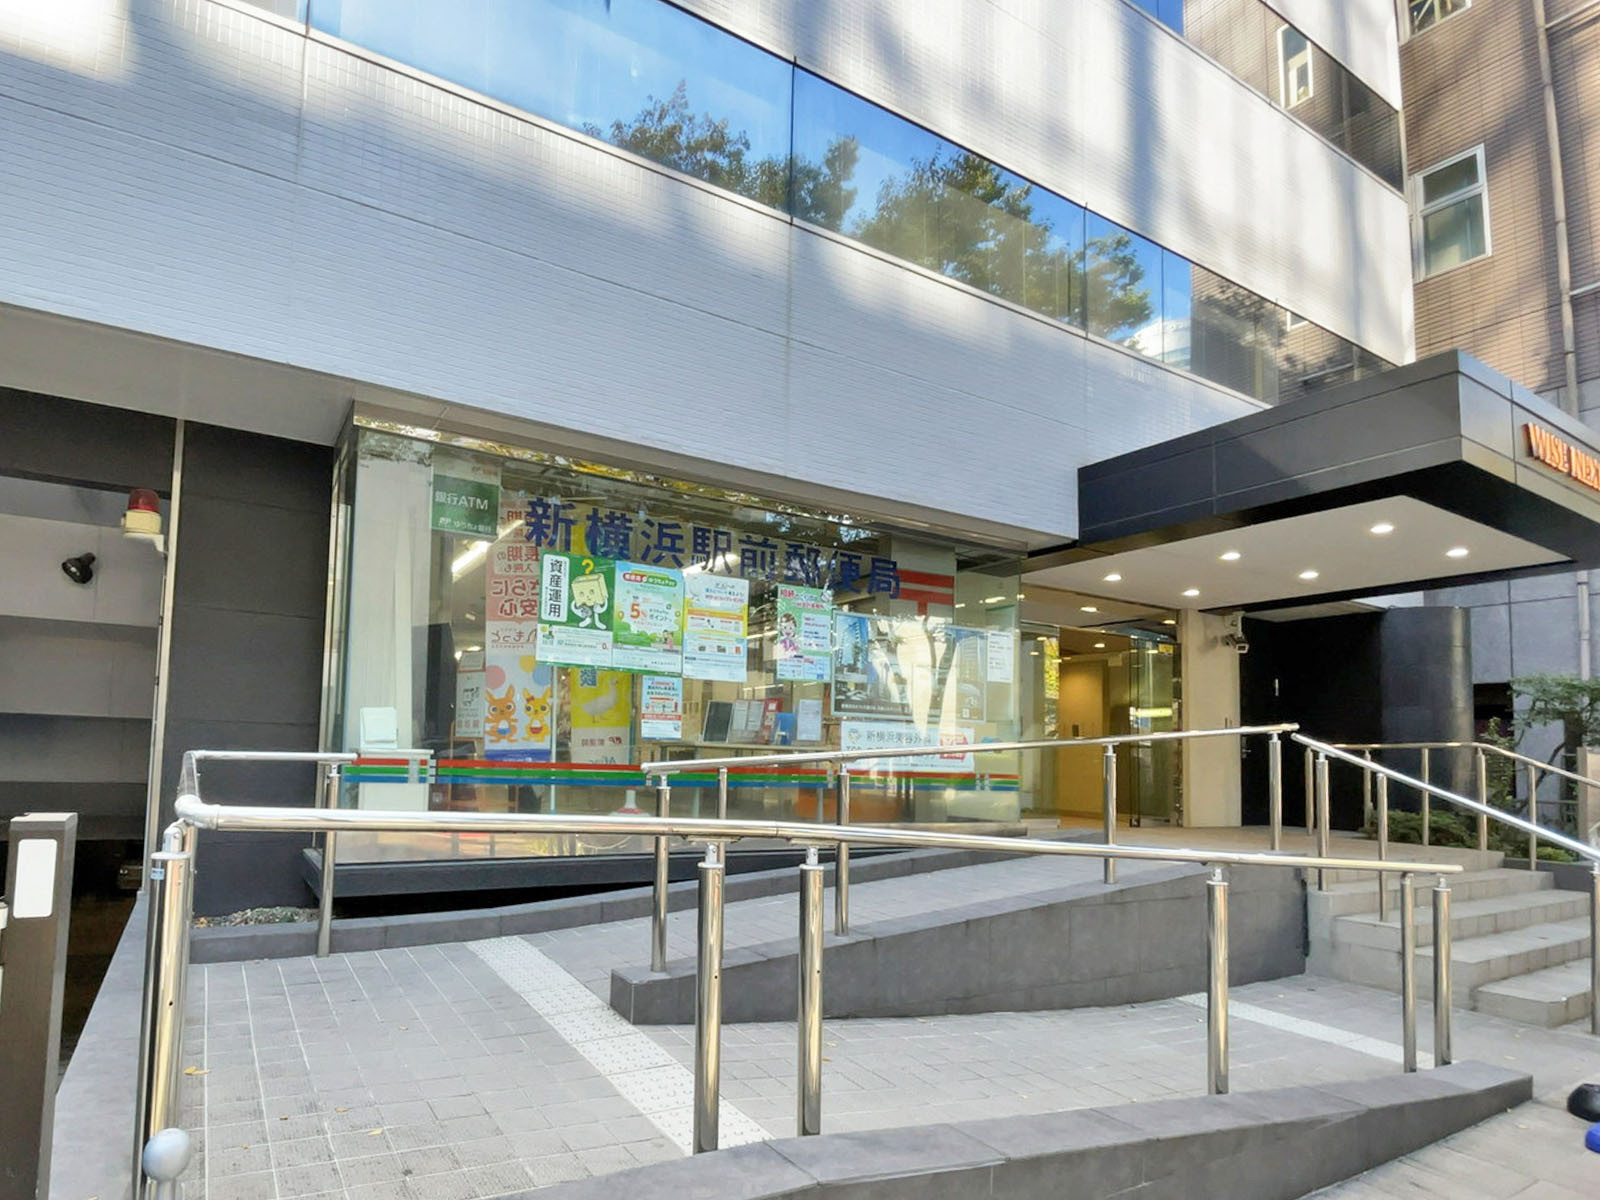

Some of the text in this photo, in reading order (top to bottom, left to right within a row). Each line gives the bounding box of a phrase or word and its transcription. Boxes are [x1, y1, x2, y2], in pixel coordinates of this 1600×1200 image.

[1522, 421, 1569, 473] WISE
[524, 496, 902, 600] 新横浜駅前郵便局
[548, 559, 563, 618] 資産運用
